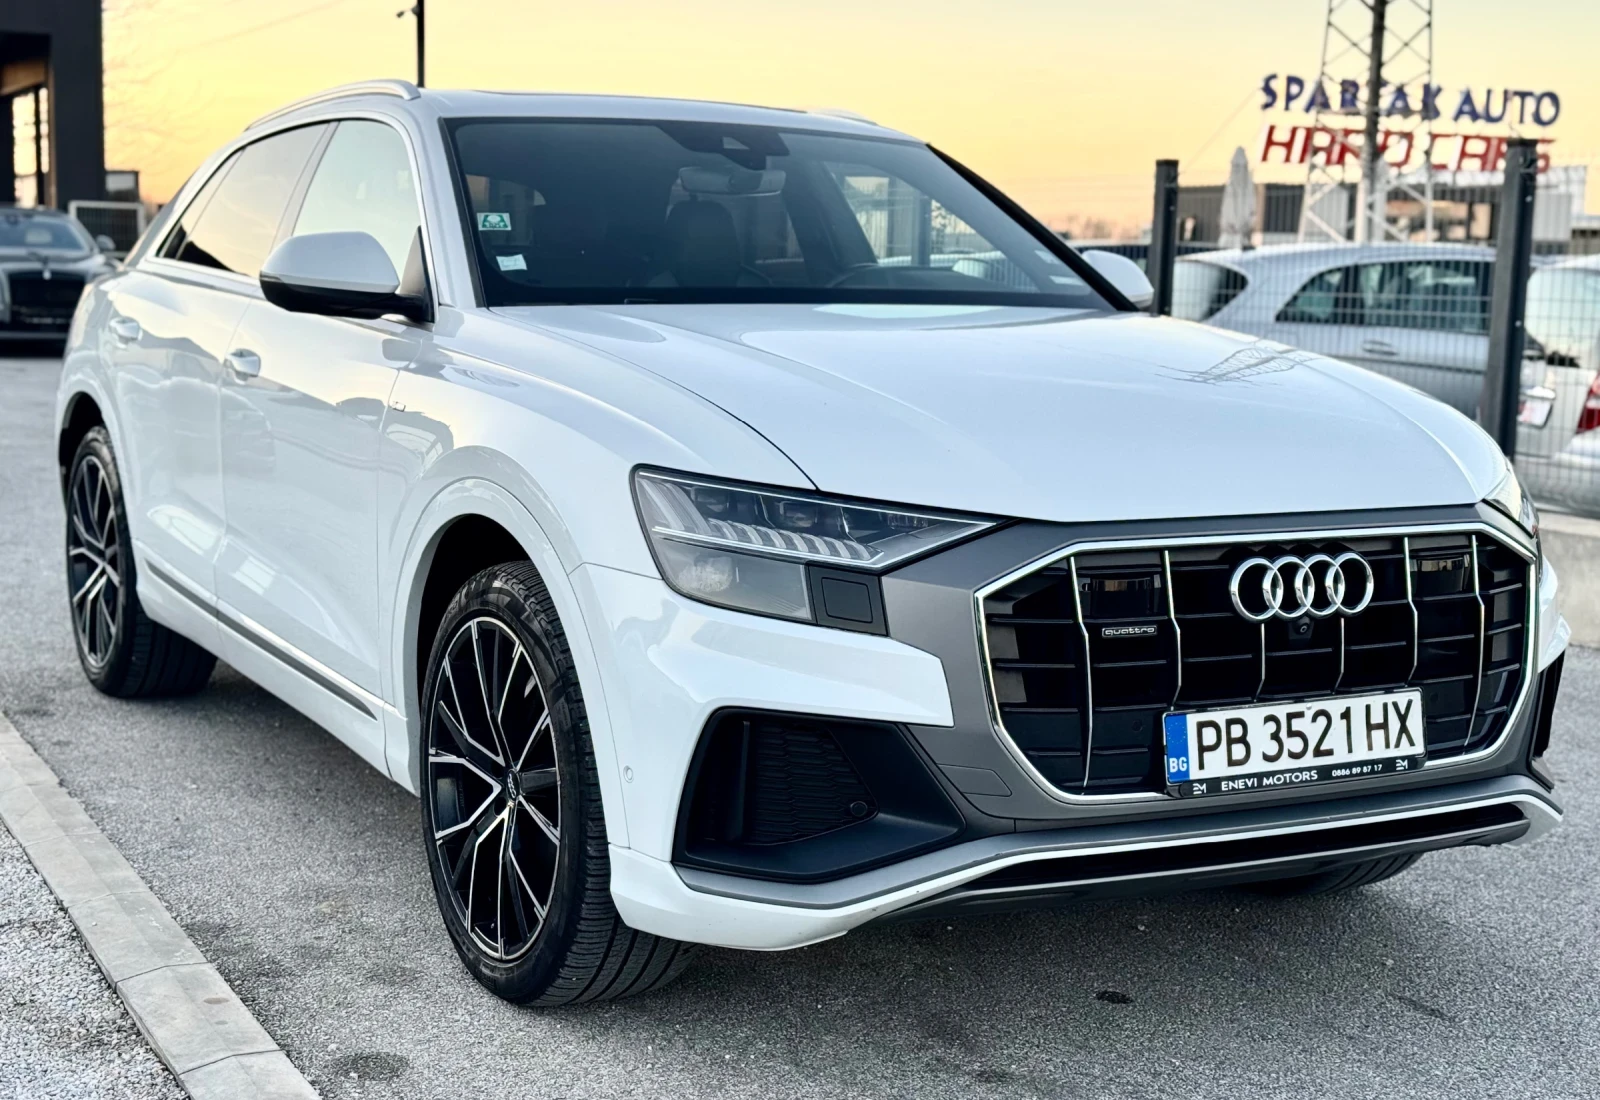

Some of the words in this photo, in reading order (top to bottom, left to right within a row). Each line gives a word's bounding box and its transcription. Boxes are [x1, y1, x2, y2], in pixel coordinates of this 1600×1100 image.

[1261, 73, 1442, 121] SPARAK
[1452, 87, 1561, 126] AUTO
[1105, 627, 1155, 636] quattro
[1196, 717, 1251, 770] PB
[1262, 706, 1353, 763] 3521
[1365, 698, 1416, 752] HX
[1169, 757, 1188, 773] BG
[1221, 778, 1258, 791] ENEVI
[1262, 770, 1318, 787] MOTORS
[1331, 769, 1351, 777] 0886
[1373, 764, 1383, 772] 17
